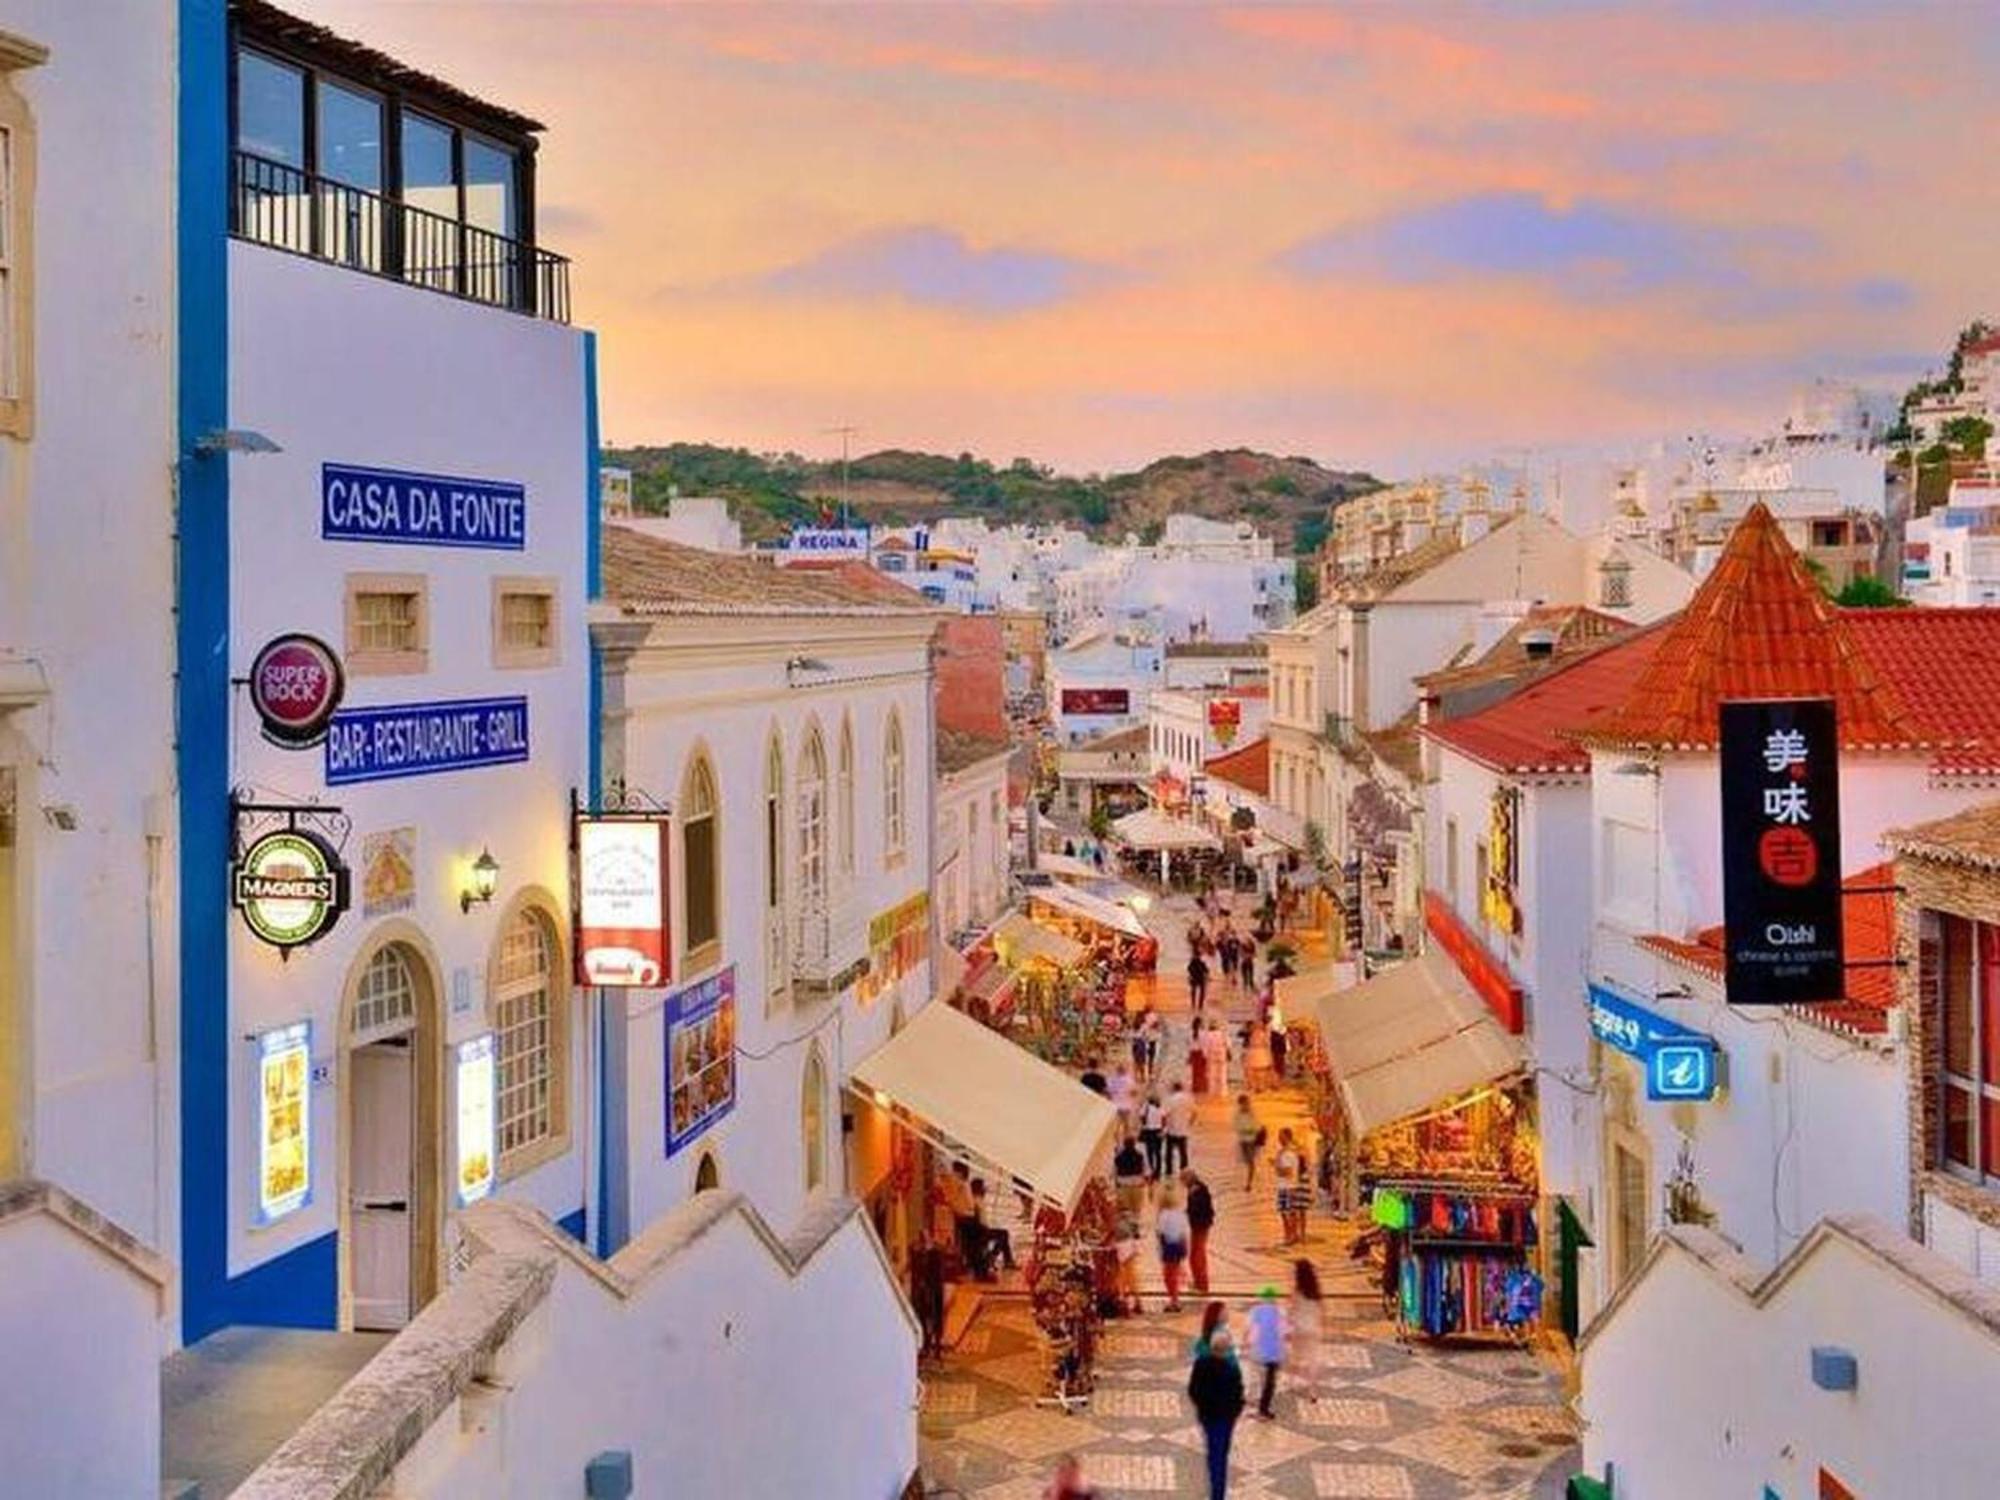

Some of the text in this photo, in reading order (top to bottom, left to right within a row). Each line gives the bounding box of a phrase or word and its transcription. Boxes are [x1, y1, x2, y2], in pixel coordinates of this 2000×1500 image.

[327, 480, 522, 538] CASA DA FONTE
[800, 535, 859, 549] REGINA
[265, 665, 321, 683] SUPER
[265, 684, 316, 701] BOCK
[243, 879, 329, 899] MAGNERS
